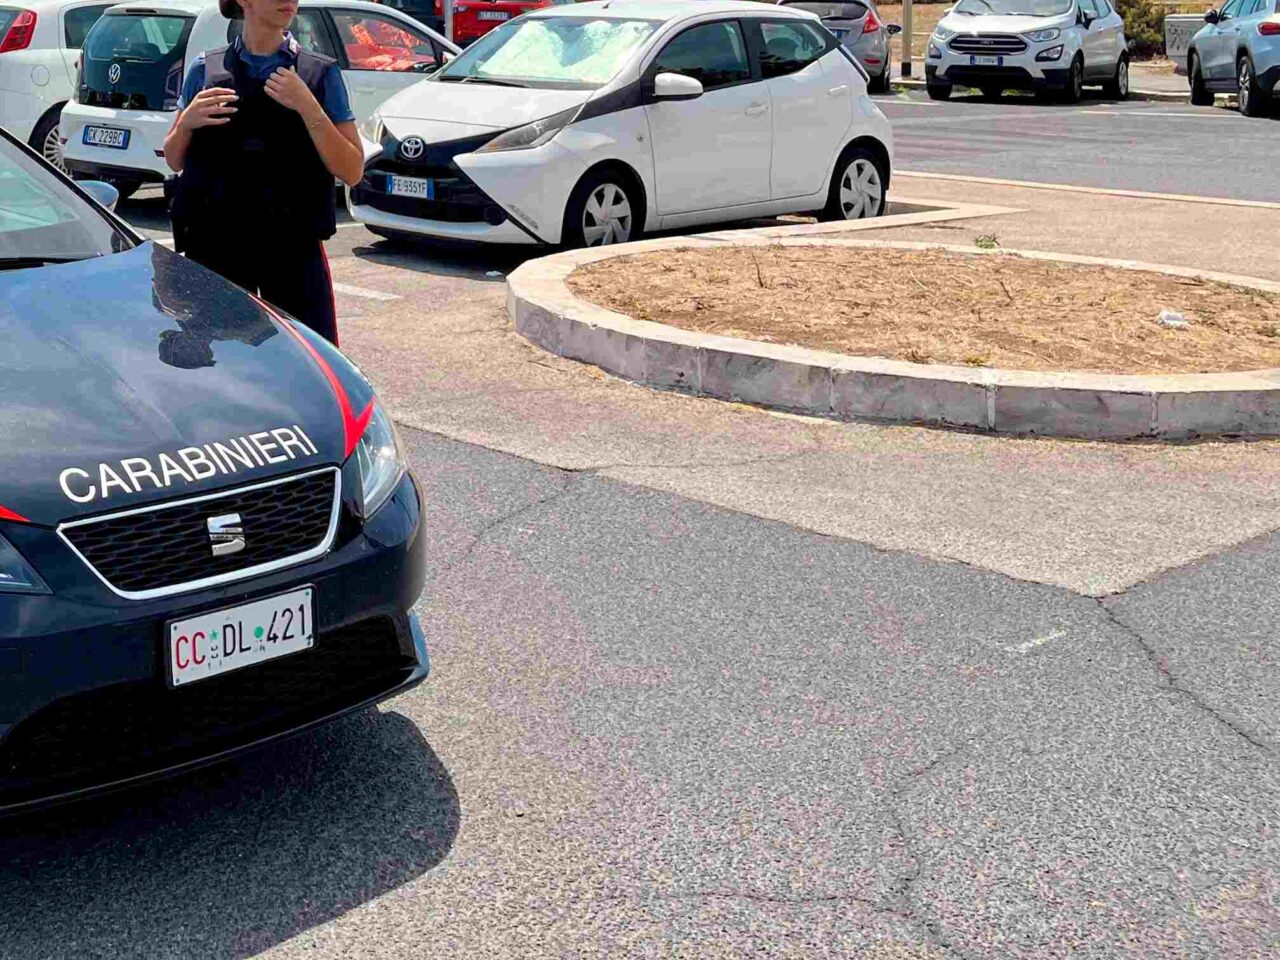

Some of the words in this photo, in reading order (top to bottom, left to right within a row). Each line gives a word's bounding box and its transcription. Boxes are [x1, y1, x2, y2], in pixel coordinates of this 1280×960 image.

[58, 424, 319, 503] CARABINIERI
[174, 631, 206, 670] CC
[222, 620, 252, 658] DL
[266, 603, 306, 644] 421
